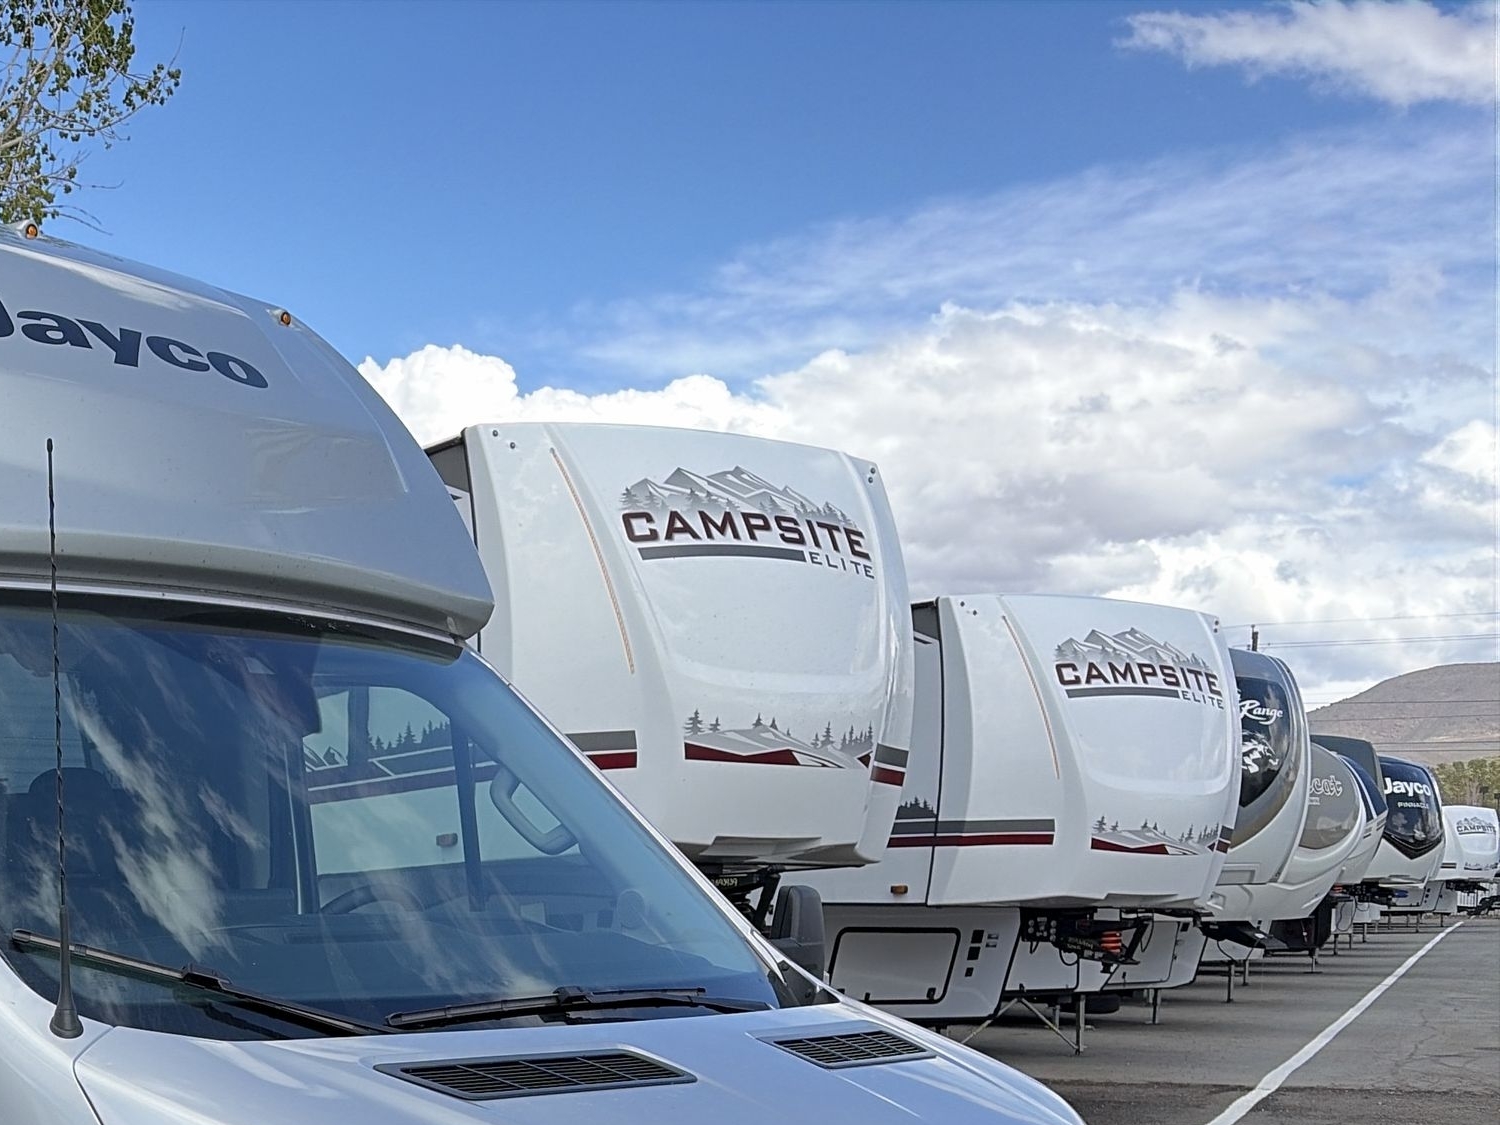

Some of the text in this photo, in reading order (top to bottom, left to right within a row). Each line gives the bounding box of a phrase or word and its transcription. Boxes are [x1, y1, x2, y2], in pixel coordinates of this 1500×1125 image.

[621, 510, 871, 561] CAMPSITE
[809, 551, 875, 579] ELITE
[1055, 661, 1223, 697] CAMPSITE
[1181, 690, 1225, 710] ELITE
[1239, 699, 1283, 725] Range
[1384, 777, 1431, 797] Jayco
